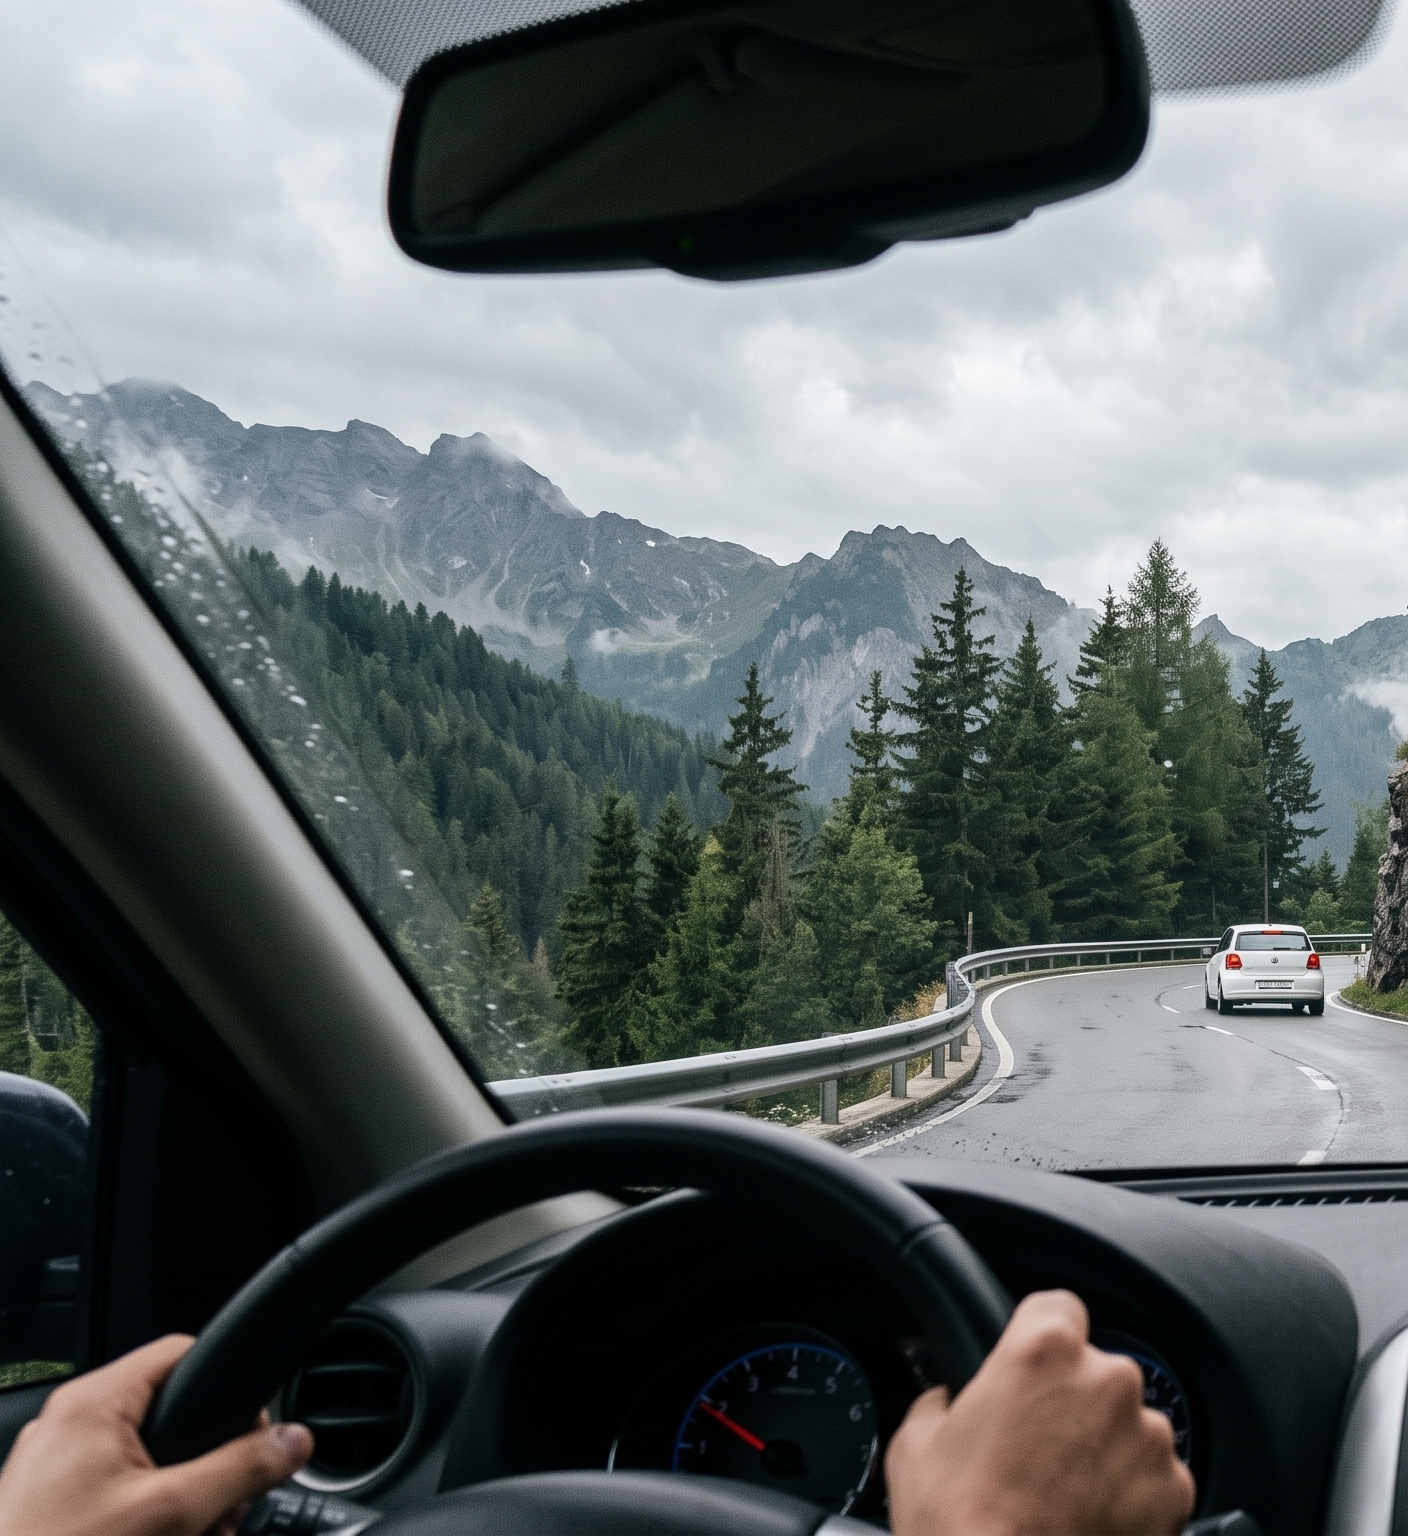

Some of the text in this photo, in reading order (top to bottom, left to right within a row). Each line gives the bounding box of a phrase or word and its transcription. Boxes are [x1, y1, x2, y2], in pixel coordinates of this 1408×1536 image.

[787, 1365, 798, 1380] 4
[748, 1376, 760, 1391] 3
[825, 1377, 837, 1394] 5
[849, 1404, 862, 1422] 6
[699, 1440, 706, 1455] 1
